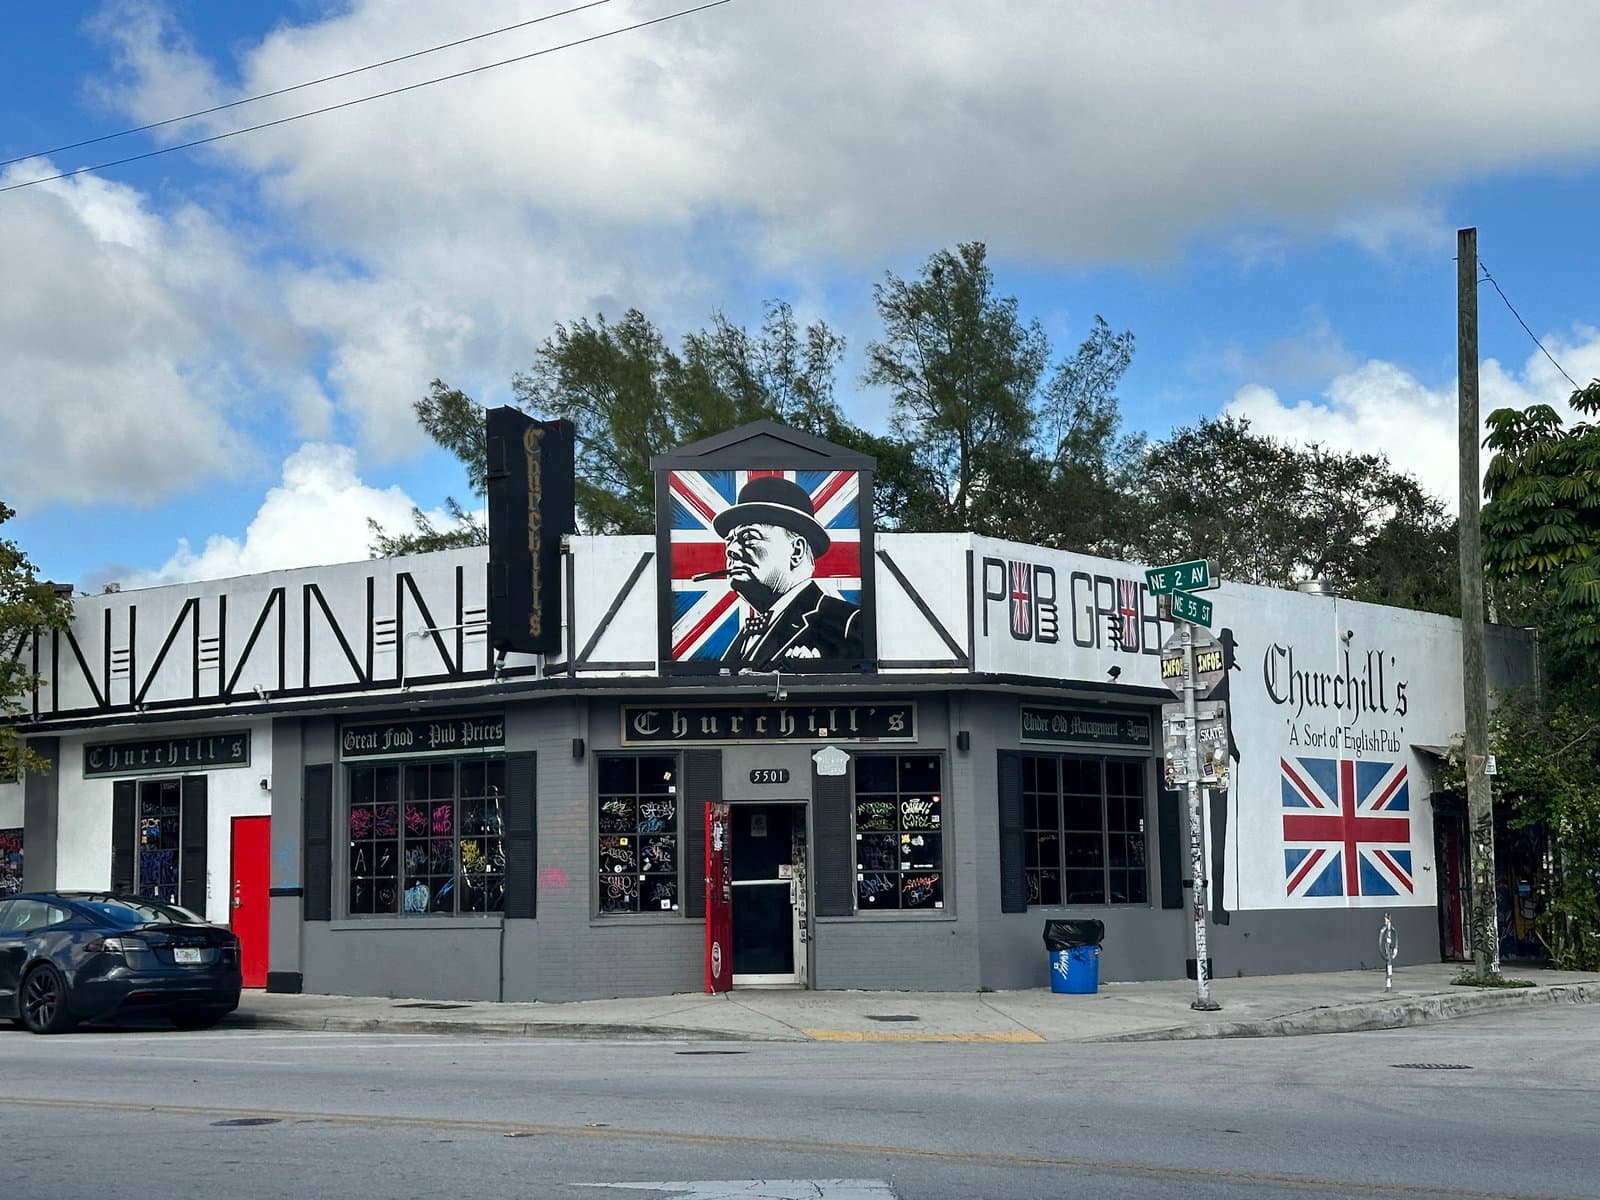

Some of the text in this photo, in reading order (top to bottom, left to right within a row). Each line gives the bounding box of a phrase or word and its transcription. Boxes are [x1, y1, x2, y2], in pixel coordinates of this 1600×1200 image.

[1150, 567, 1204, 589] NE 2 AV
[982, 557, 1162, 655] PUB GRUB
[1174, 595, 1211, 620] NE 55 ST
[1263, 642, 1408, 725] Churchill's
[344, 731, 378, 750] Great
[383, 727, 413, 750] Food
[428, 723, 455, 747] Pub
[461, 720, 504, 746] Prices
[633, 708, 905, 738] Churchill's
[1023, 712, 1049, 731] Under
[1052, 715, 1068, 733] Old
[1304, 723, 1327, 748] Sort
[1329, 726, 1342, 749] of
[89, 738, 242, 769] Churchill's
[754, 772, 784, 782] 5501
